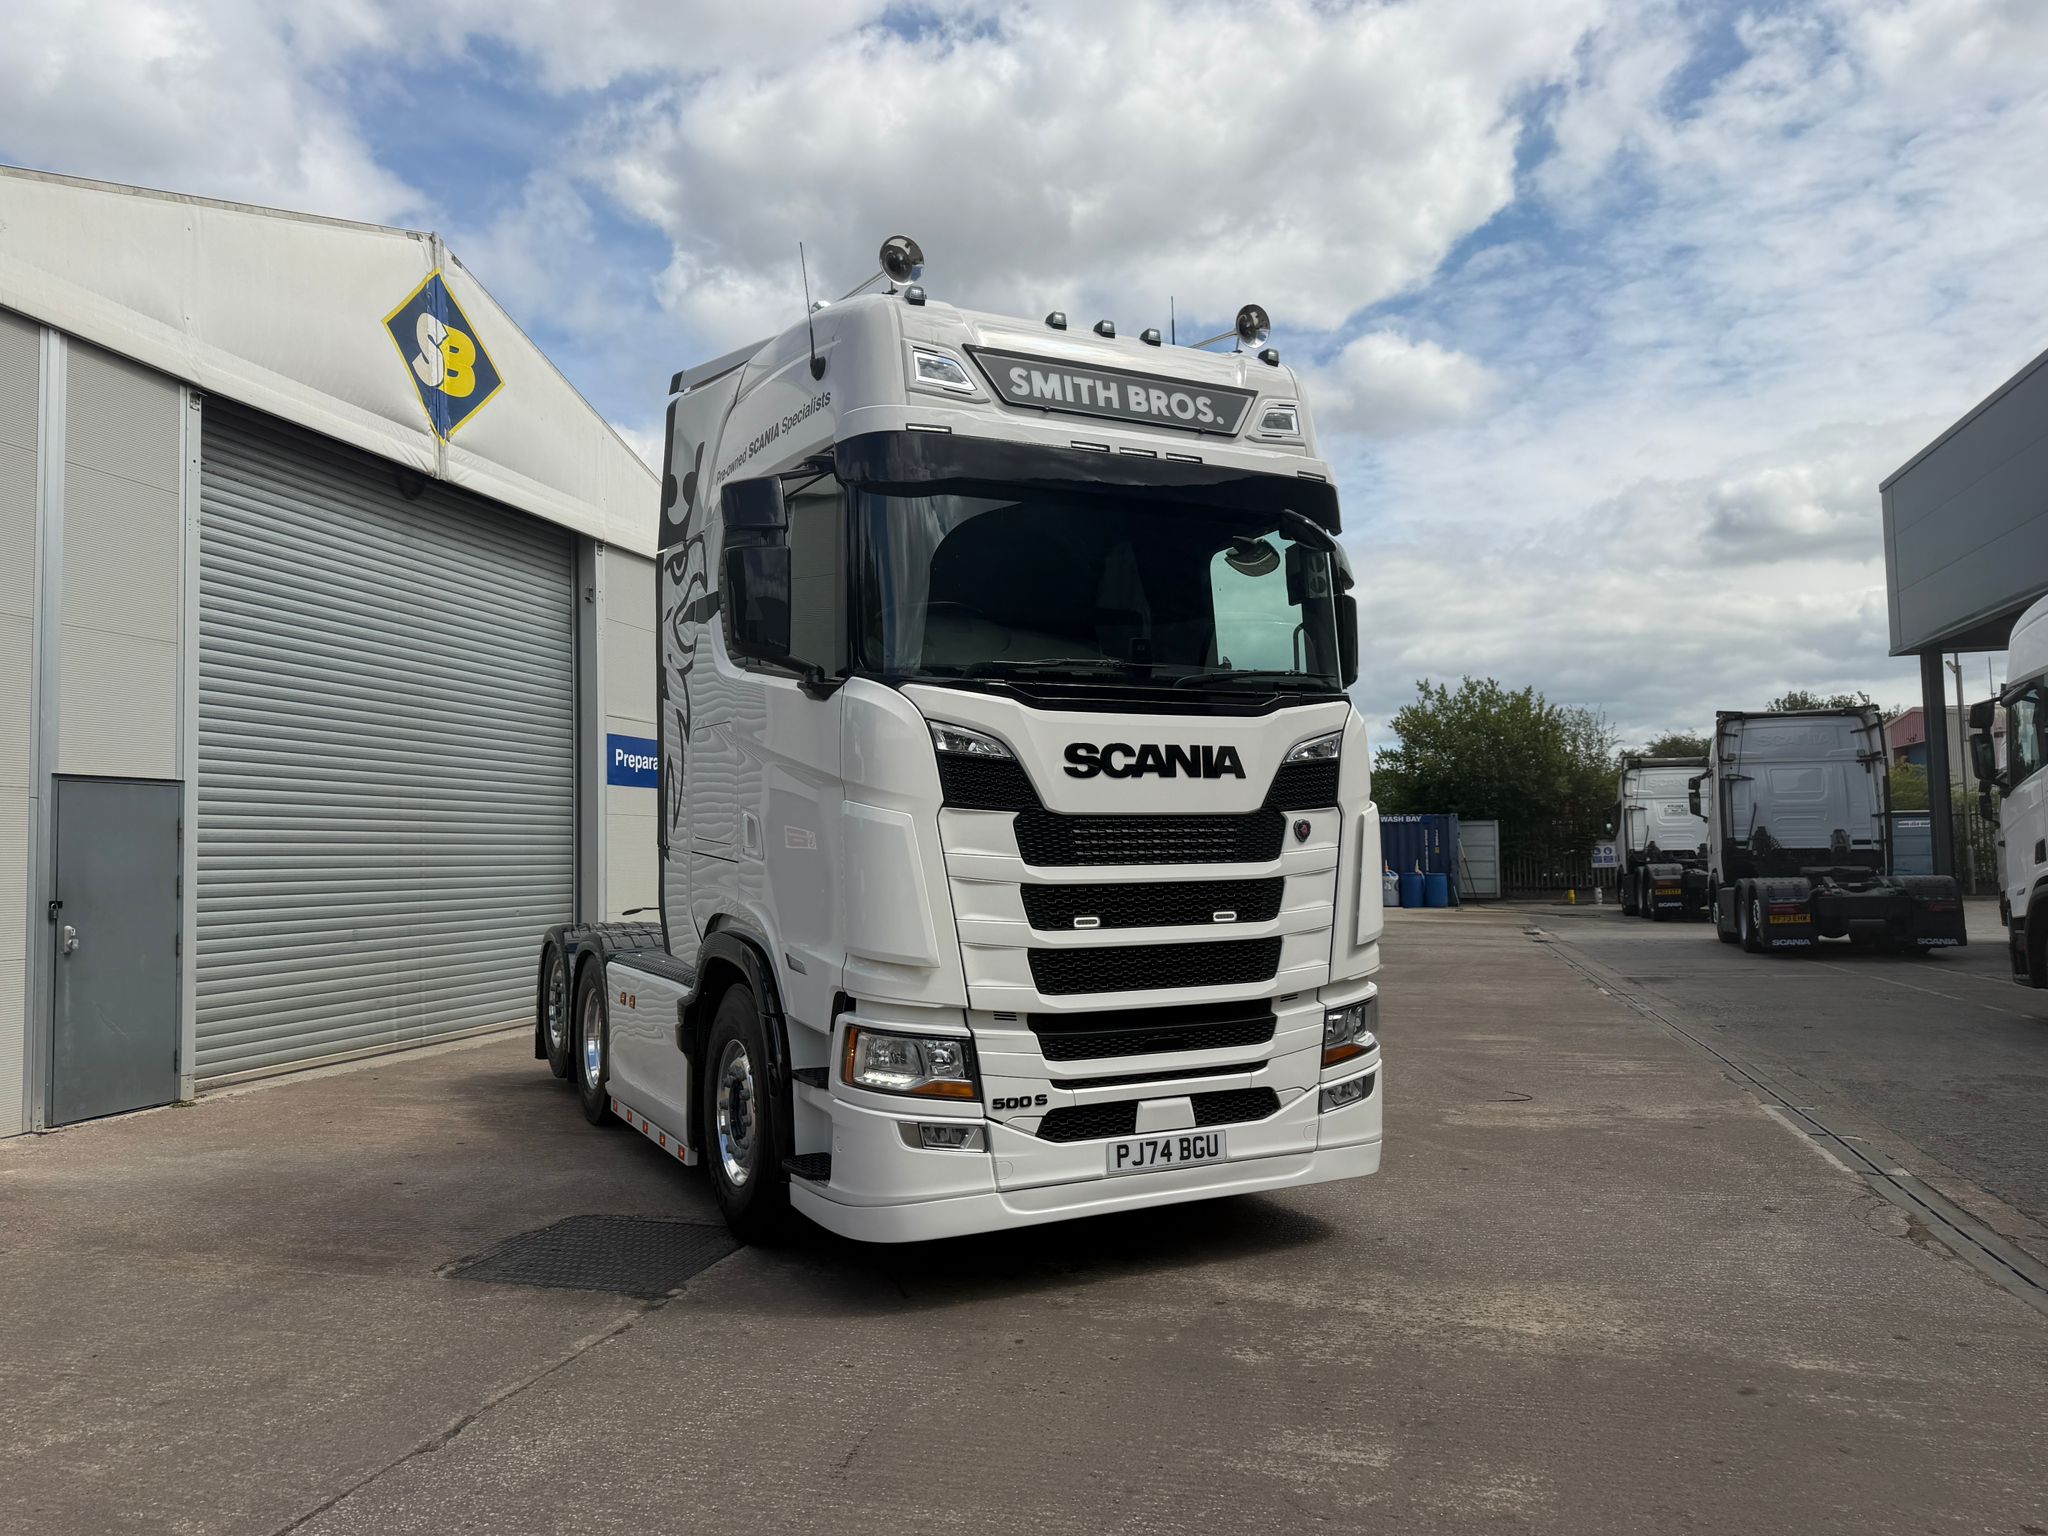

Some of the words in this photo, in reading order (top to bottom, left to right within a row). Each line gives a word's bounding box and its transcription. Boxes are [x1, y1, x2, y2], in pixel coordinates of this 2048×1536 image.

[412, 312, 477, 398] SB
[1009, 367, 1121, 409] SMITH
[1127, 385, 1225, 425] BROS.
[716, 447, 748, 486] Pre-owned
[748, 422, 780, 459] SCANIA
[781, 391, 831, 435] Specialists
[1063, 742, 1247, 779] SCANIA
[1772, 938, 1811, 946] SCANIA
[1917, 937, 1958, 945] SCANIA
[992, 1096, 1032, 1109] 500
[1034, 1094, 1048, 1106] S
[1116, 1139, 1172, 1168] PJ74
[1179, 1134, 1219, 1161] BGU
